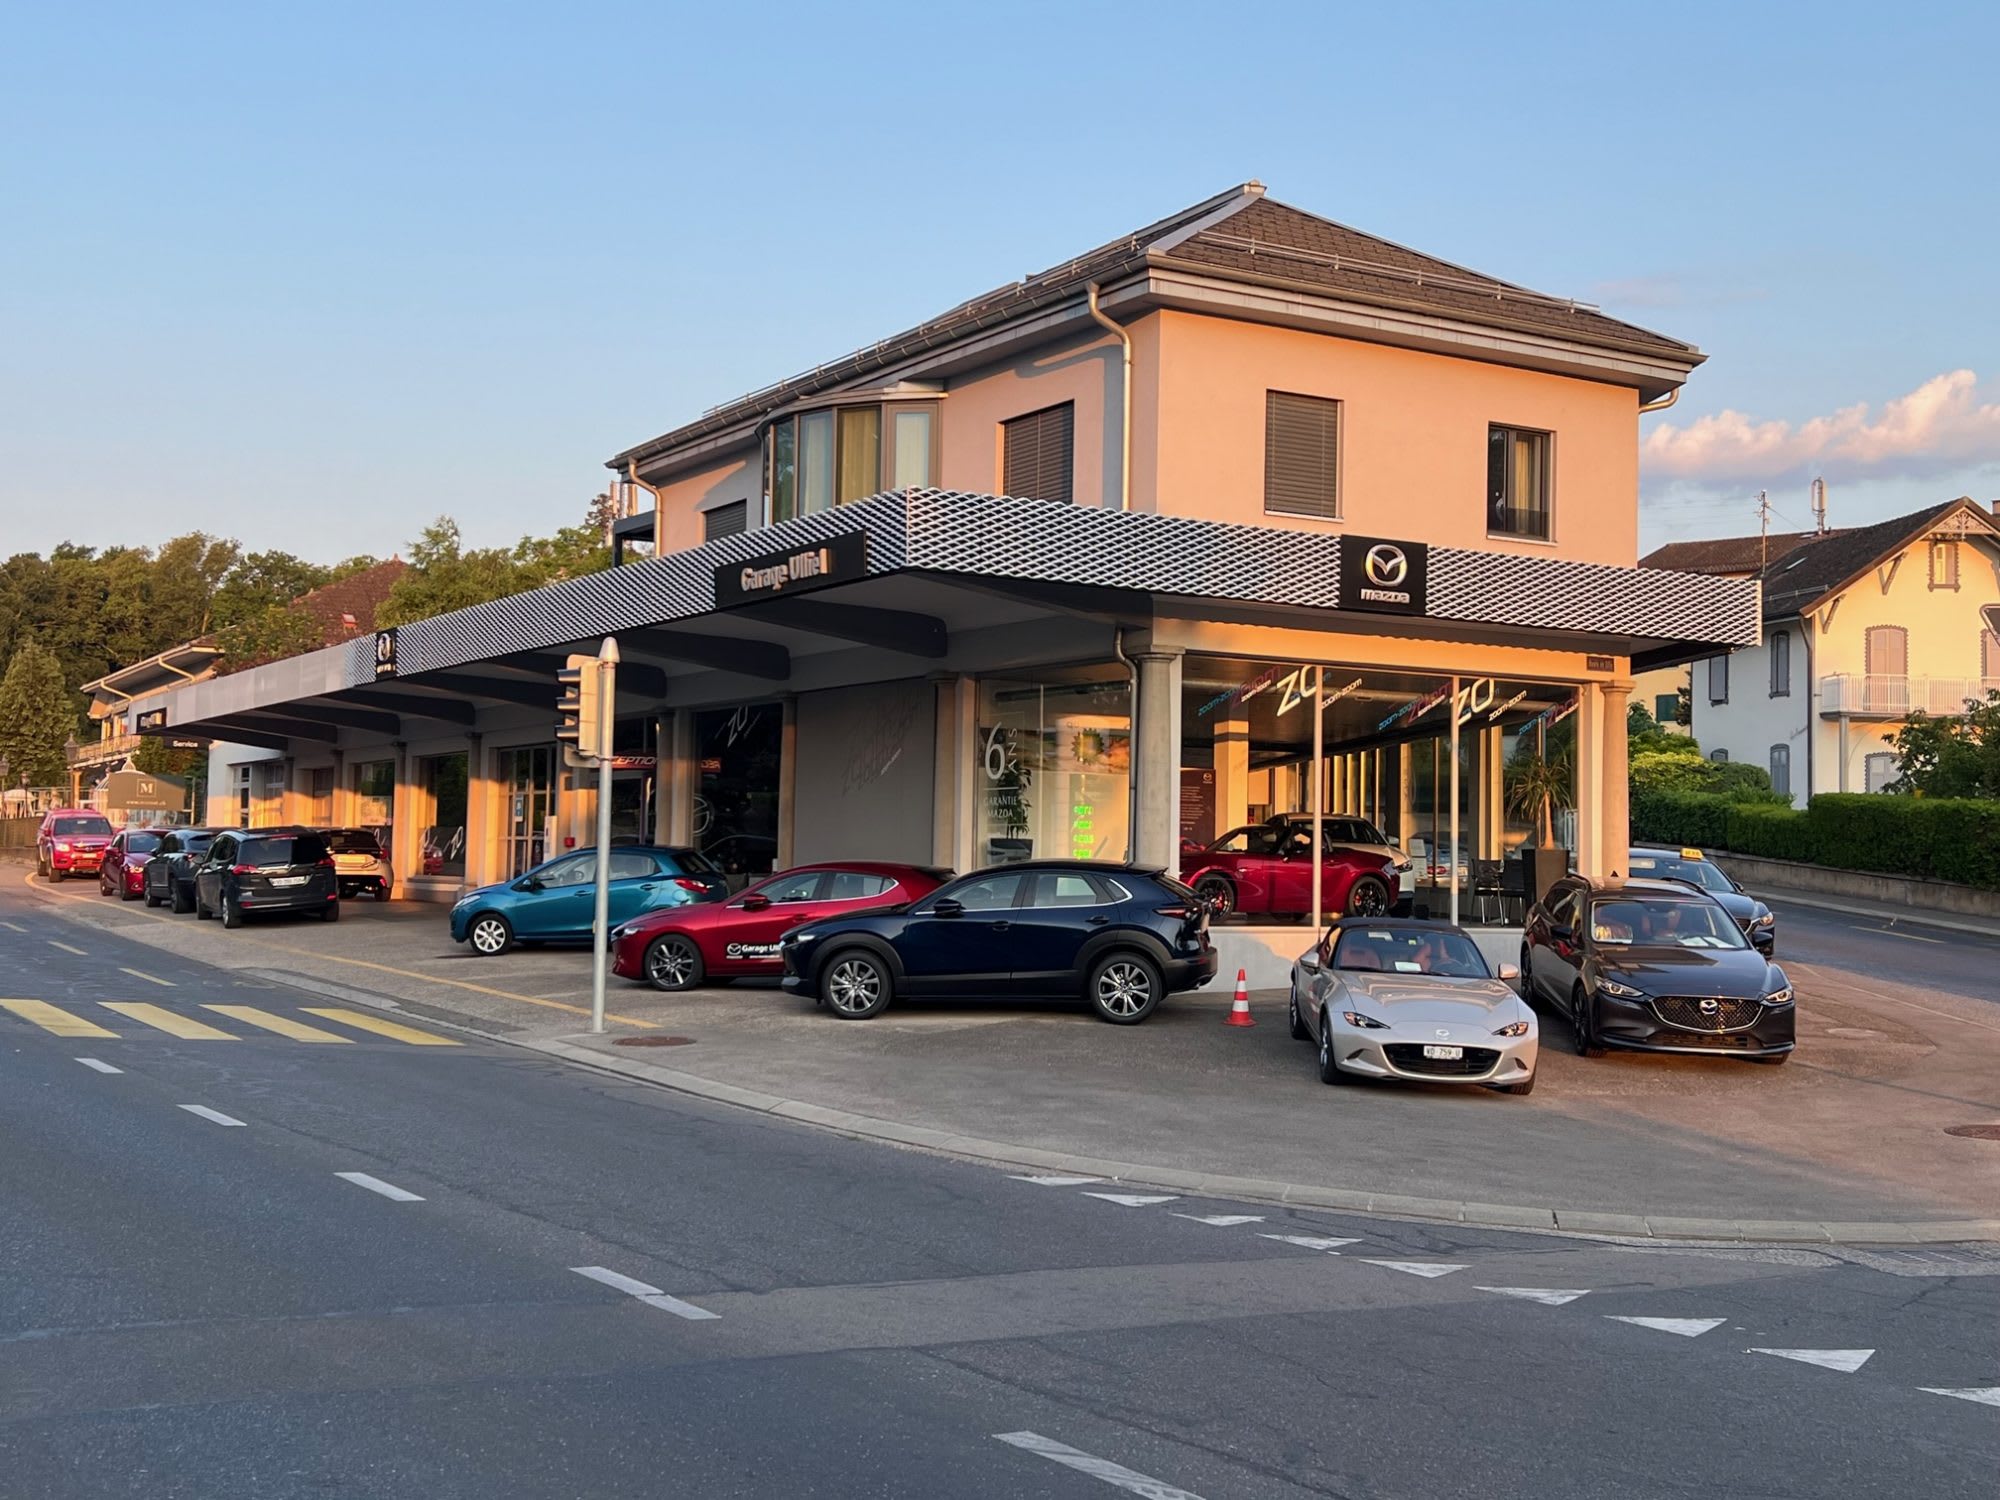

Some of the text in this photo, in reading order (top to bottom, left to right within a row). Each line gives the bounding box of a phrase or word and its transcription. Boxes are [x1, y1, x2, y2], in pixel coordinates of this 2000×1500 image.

[741, 564, 789, 592] Garage
[1360, 588, 1410, 604] mazda
[1489, 689, 1527, 722] zoom-zoom
[985, 721, 1006, 780] 6
[1008, 728, 1018, 774] ANS
[140, 783, 154, 794] M
[742, 944, 769, 954] Garage
